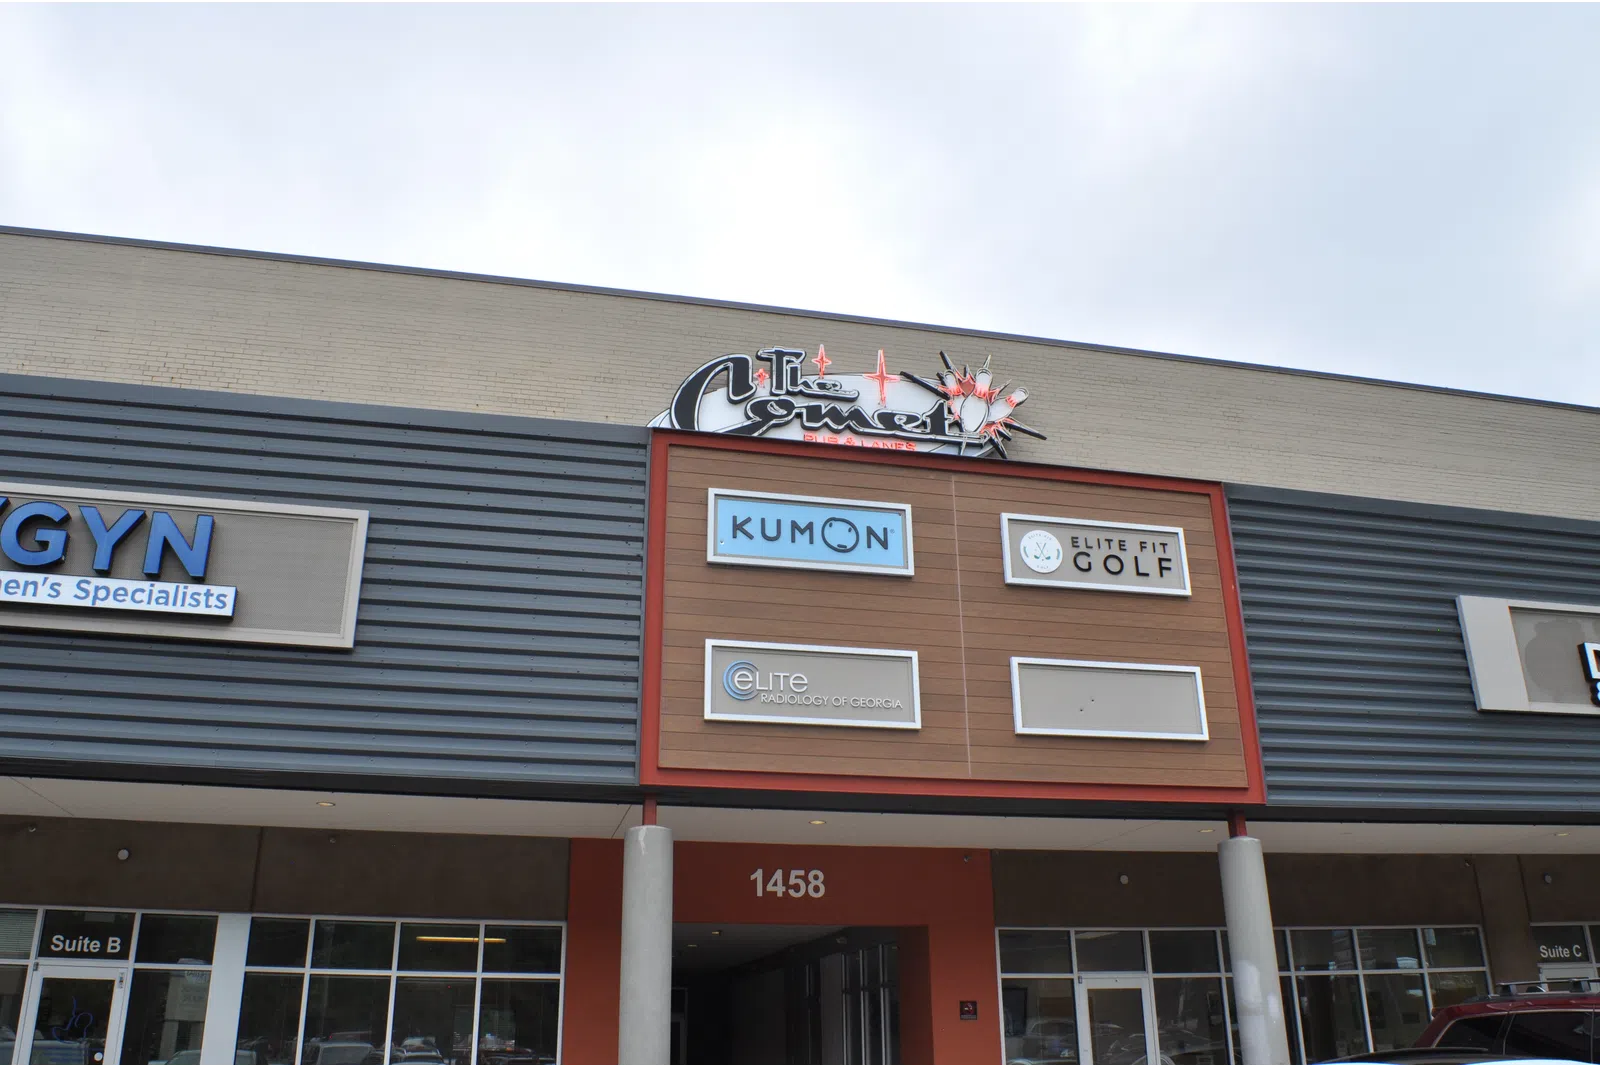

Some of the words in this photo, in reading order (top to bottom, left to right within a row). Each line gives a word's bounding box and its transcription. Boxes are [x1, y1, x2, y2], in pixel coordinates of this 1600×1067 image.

[756, 346, 860, 402] The
[670, 354, 989, 444] Comet
[803, 433, 839, 443] PUB
[861, 439, 917, 450] LANES
[0, 496, 216, 580] GYN
[732, 515, 889, 553] KUMON
[1071, 536, 1127, 552] ELITE
[1140, 541, 1168, 554] FIT
[1073, 551, 1172, 577] GOLF
[0, 577, 62, 598] en's
[73, 579, 229, 610] Specialists
[761, 693, 829, 706] RADIOLOGY
[832, 696, 847, 706] OF
[850, 697, 903, 709] GEORGIA
[750, 868, 825, 898] 1458
[51, 934, 101, 952] Suite
[107, 936, 122, 953] B
[1540, 945, 1570, 958] Suite
[1573, 945, 1582, 957] C
